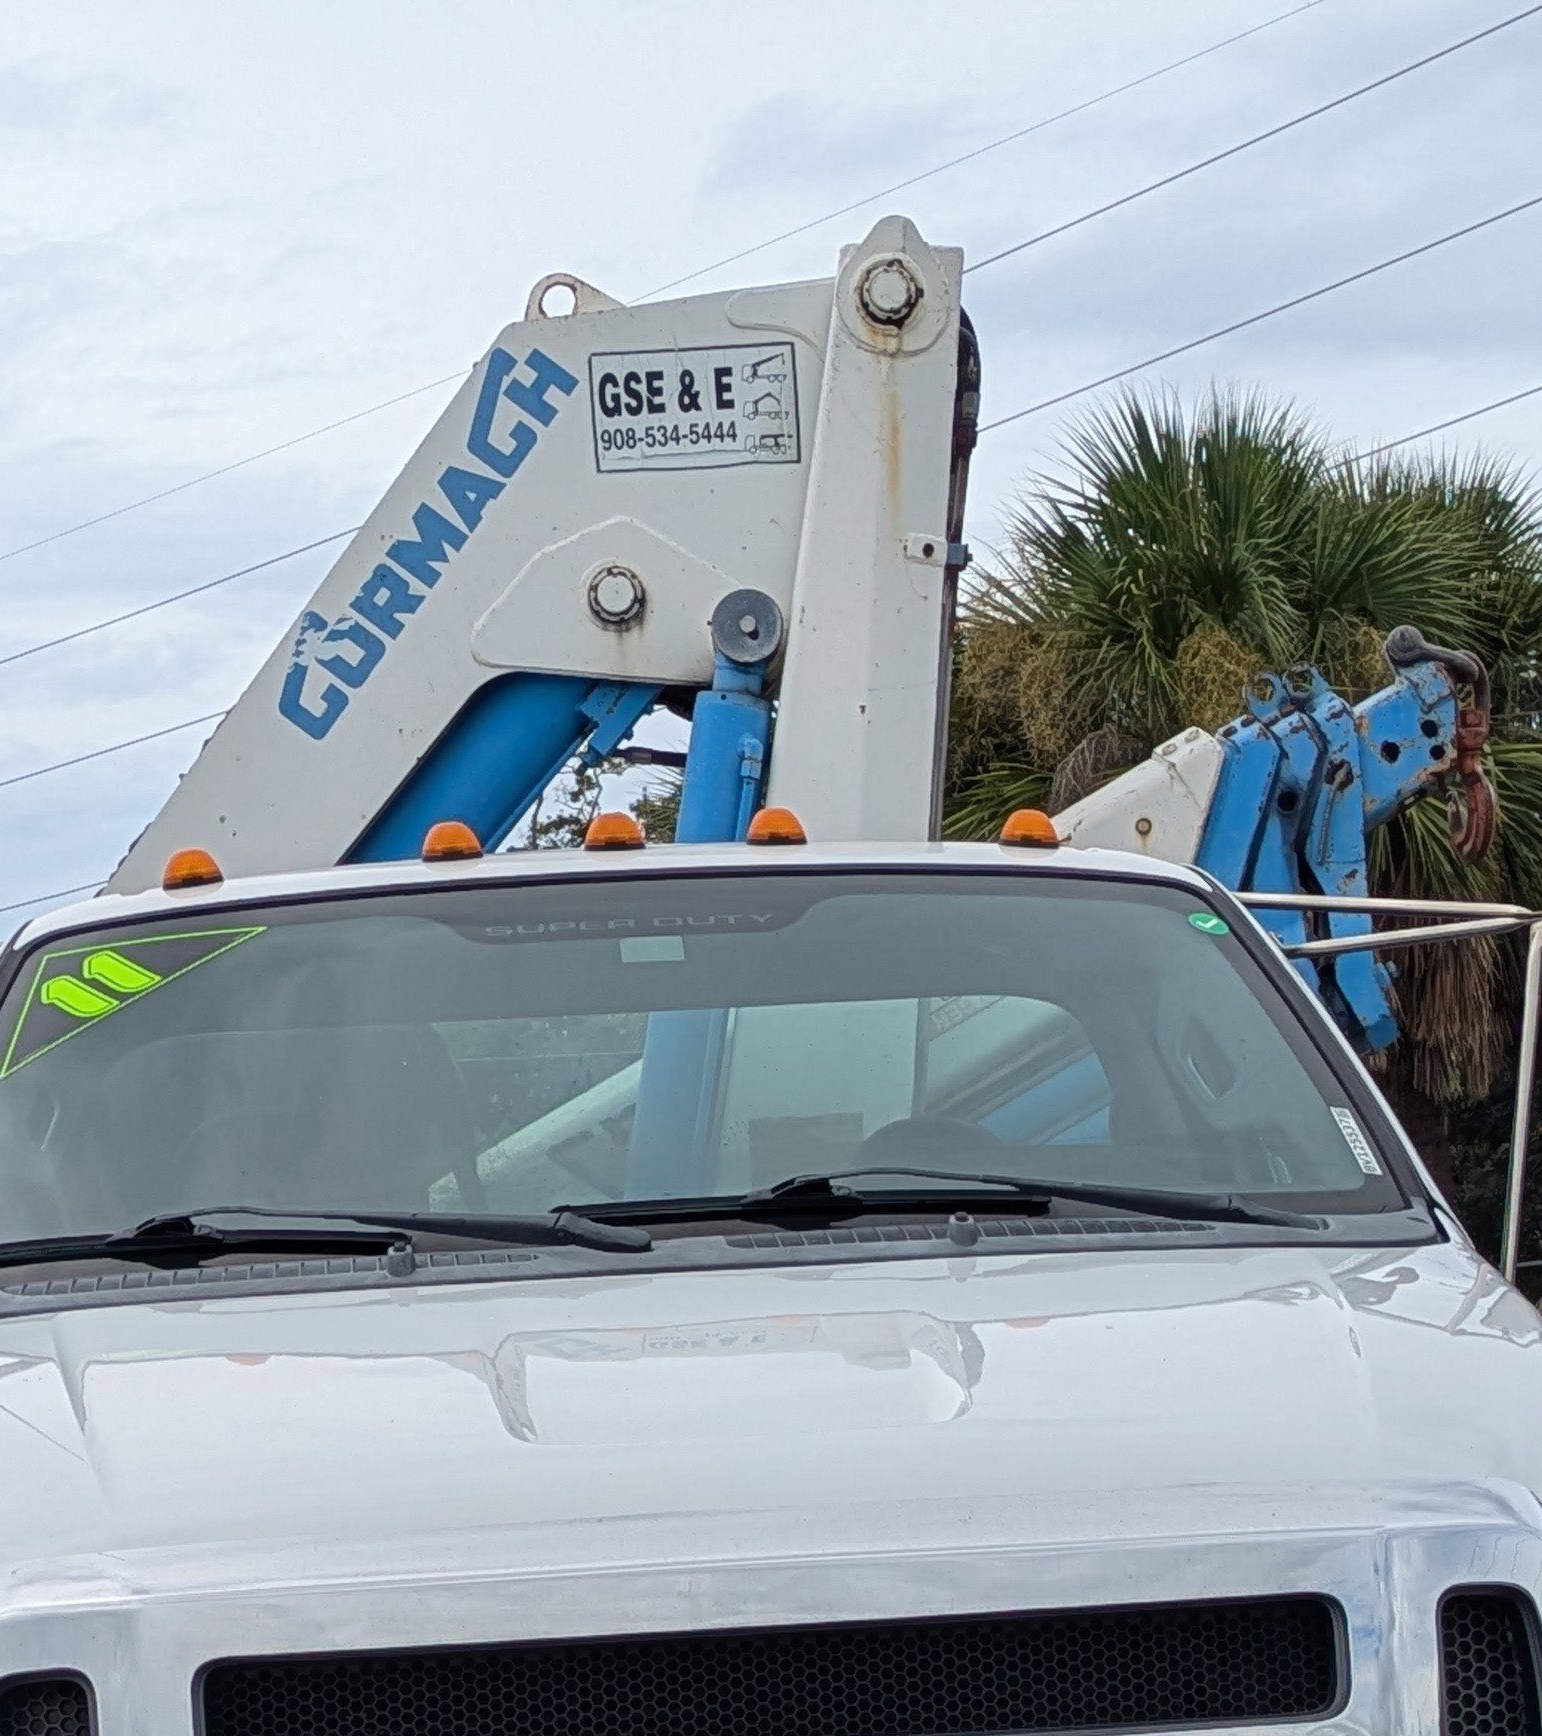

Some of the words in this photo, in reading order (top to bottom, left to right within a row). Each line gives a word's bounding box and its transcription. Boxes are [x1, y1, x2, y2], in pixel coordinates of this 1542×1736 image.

[598, 371, 667, 419] GSE
[677, 369, 703, 414] &
[713, 366, 736, 411] E
[600, 420, 739, 452] 908-534-5444
[278, 347, 580, 741] CORMACH
[485, 917, 636, 936] SUPER
[652, 913, 774, 927] DUTY
